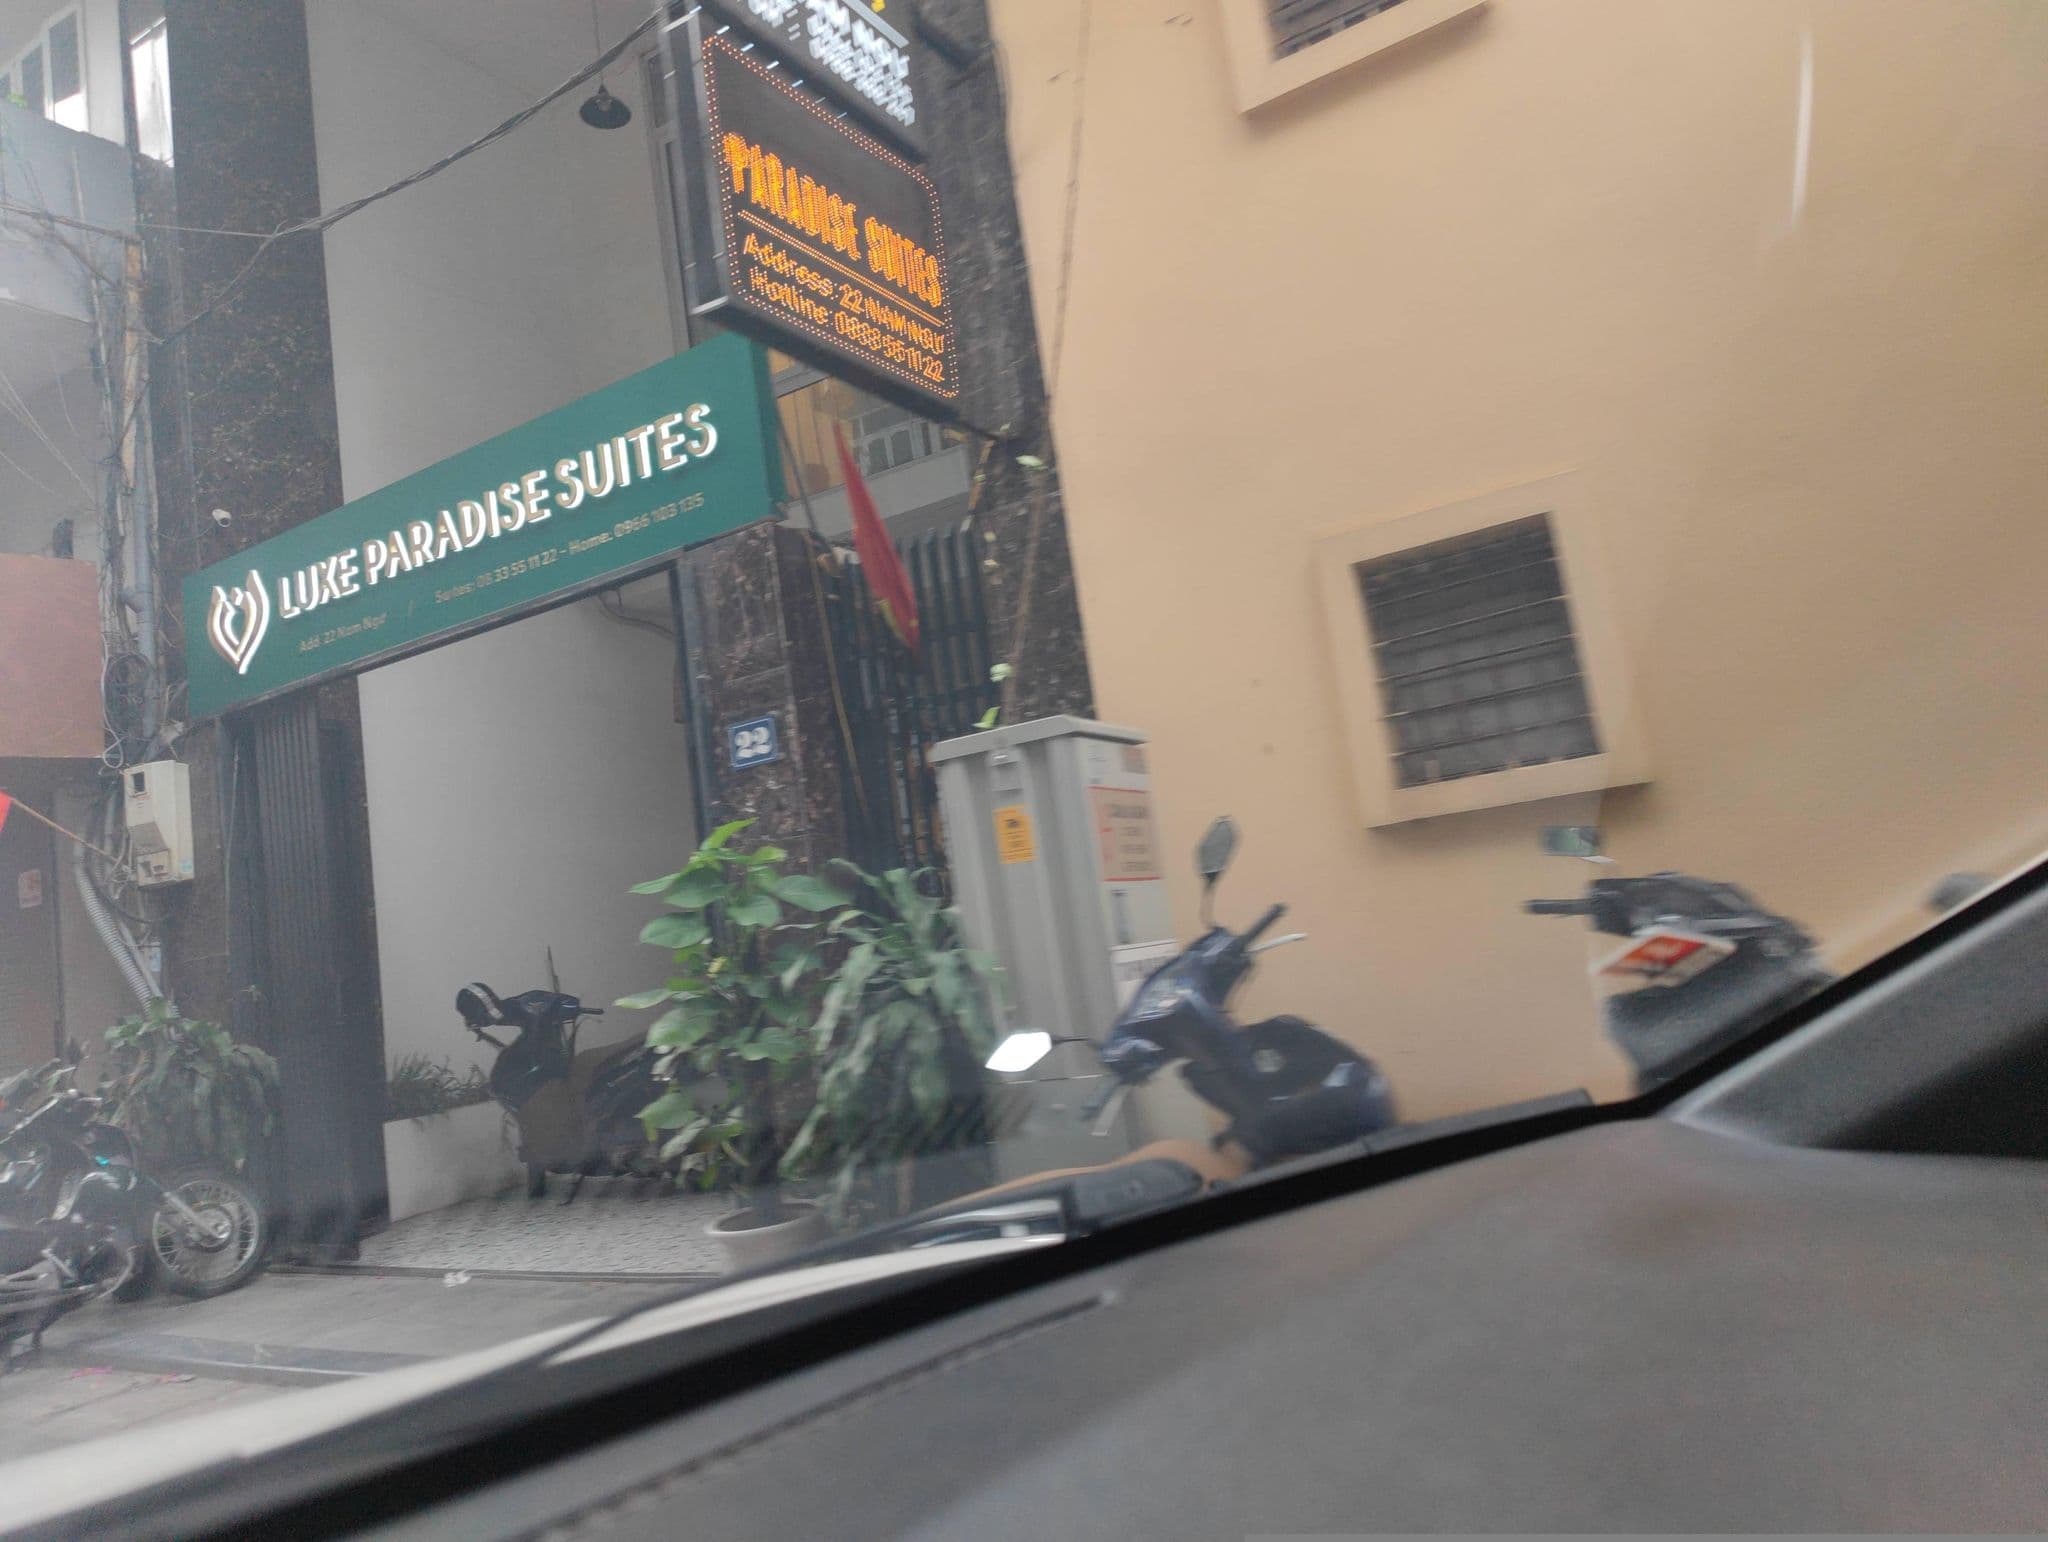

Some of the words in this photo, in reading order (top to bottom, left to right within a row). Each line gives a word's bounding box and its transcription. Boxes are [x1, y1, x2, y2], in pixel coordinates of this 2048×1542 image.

[723, 133, 861, 262] PARADISE
[864, 216, 942, 308] SUITES
[839, 284, 865, 314] 22
[277, 548, 360, 619] LUXE
[364, 469, 552, 585] PARADISE
[554, 402, 718, 508] SUITES
[541, 548, 559, 566] 22
